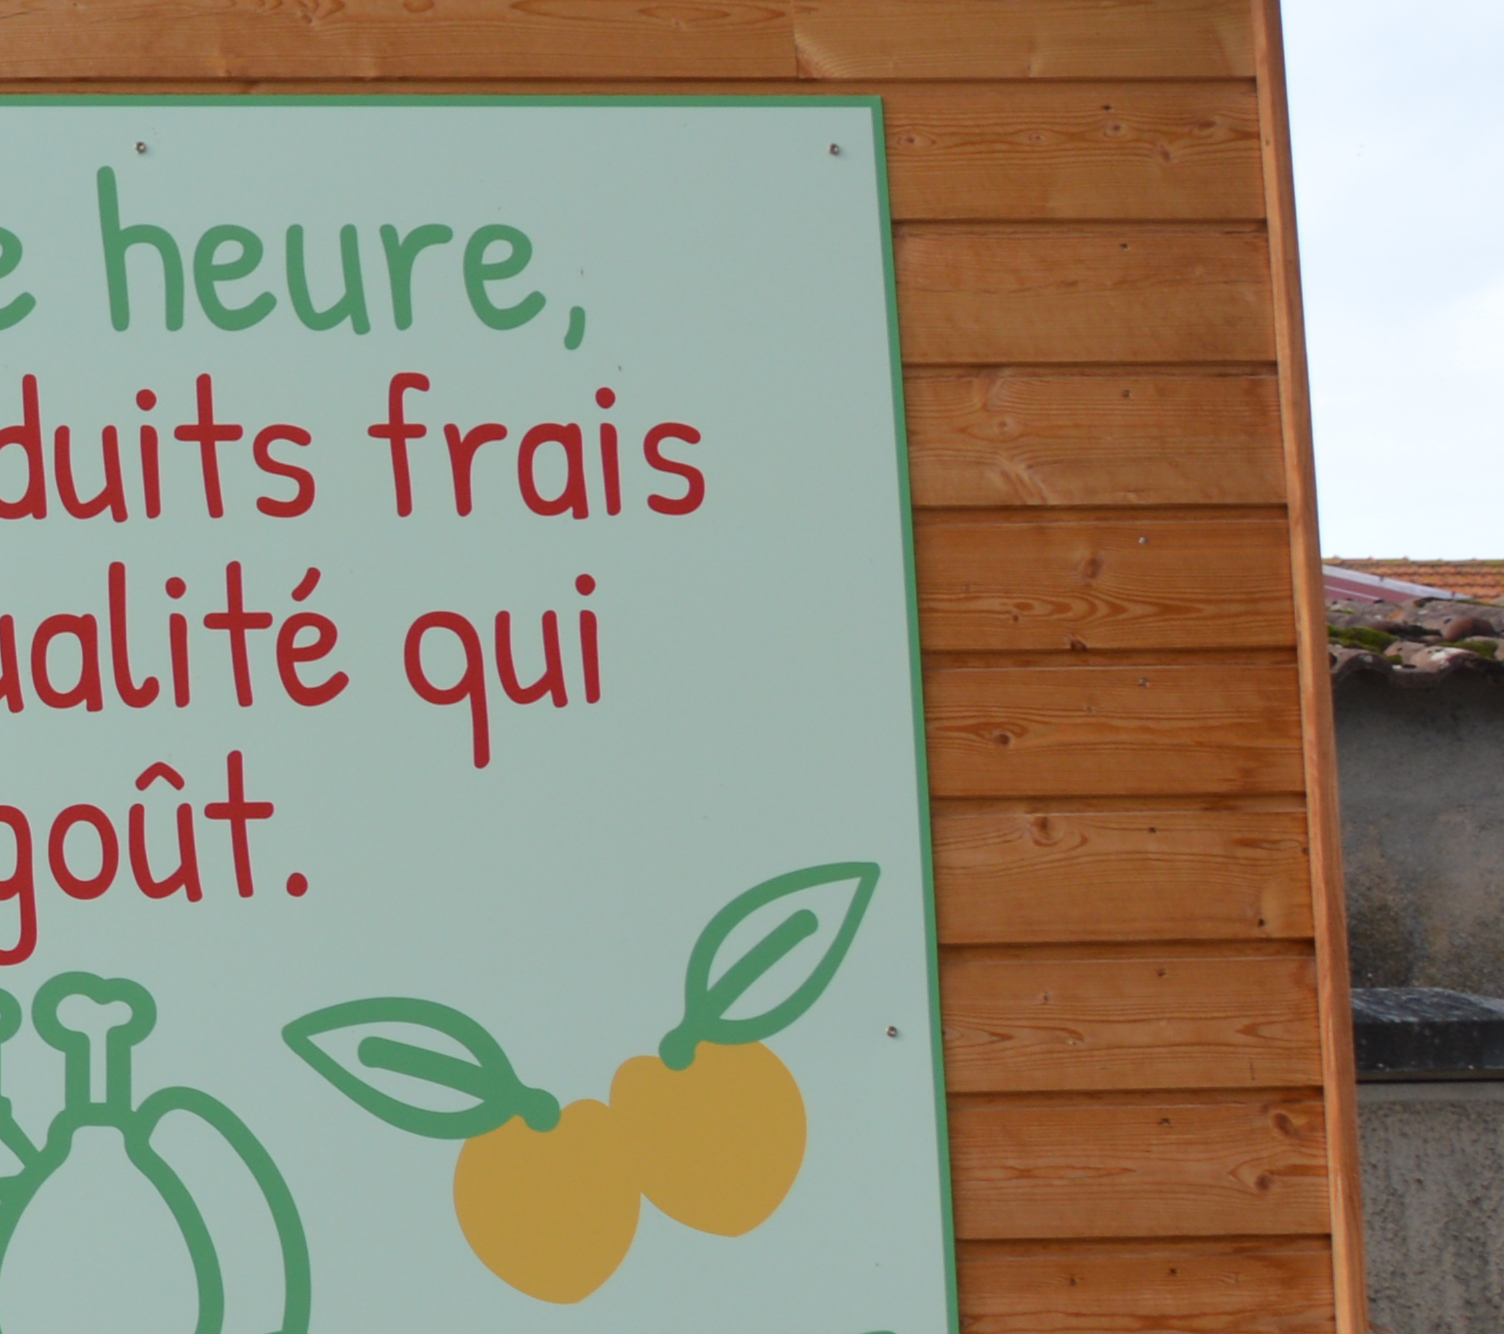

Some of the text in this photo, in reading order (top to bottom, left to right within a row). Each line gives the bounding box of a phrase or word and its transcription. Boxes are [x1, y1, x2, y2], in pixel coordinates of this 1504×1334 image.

[97, 166, 586, 350] heure,
[368, 372, 705, 520] frais
[404, 574, 600, 769] qui
